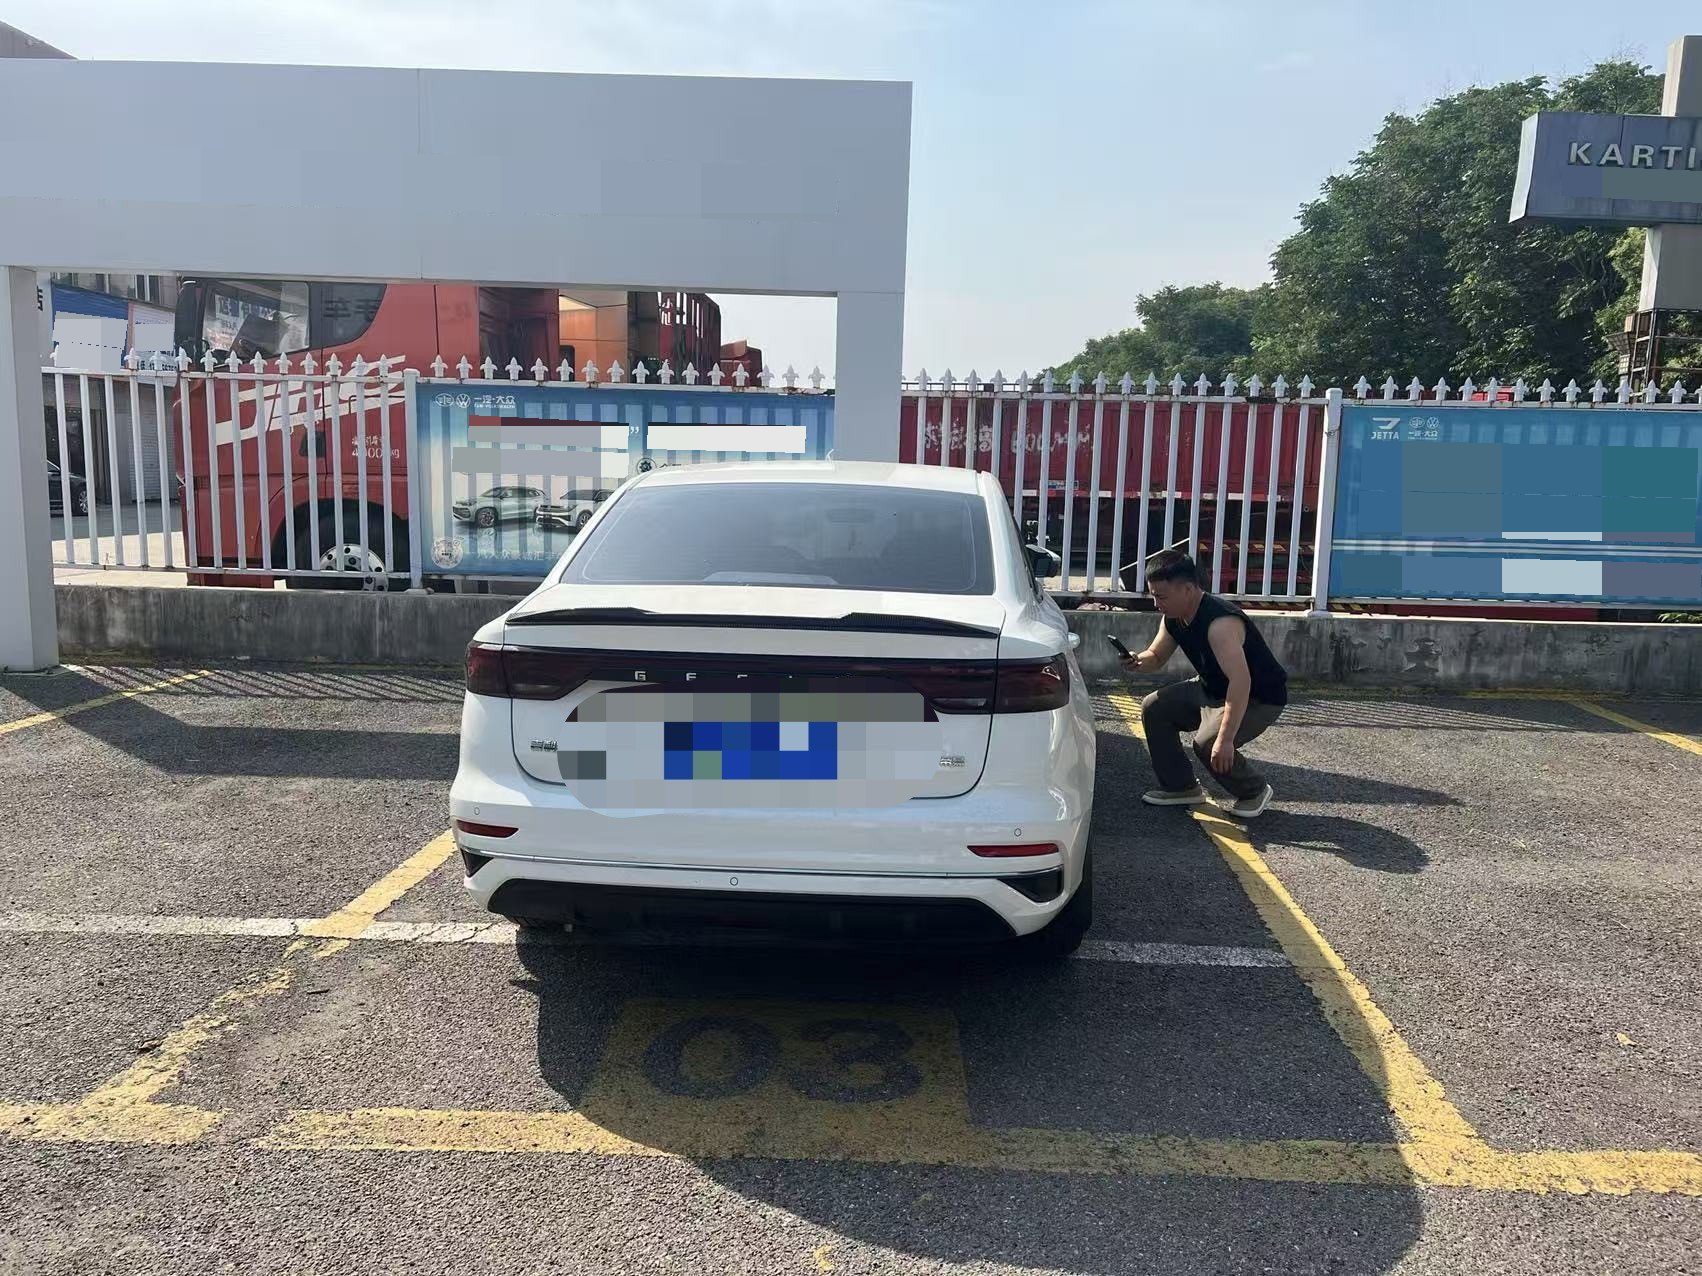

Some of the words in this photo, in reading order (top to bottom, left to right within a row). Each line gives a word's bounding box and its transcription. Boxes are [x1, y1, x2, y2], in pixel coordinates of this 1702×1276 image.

[1569, 142, 1697, 169] KARTI
[1371, 431, 1400, 440] JETTA
[643, 1014, 924, 1103] 03
